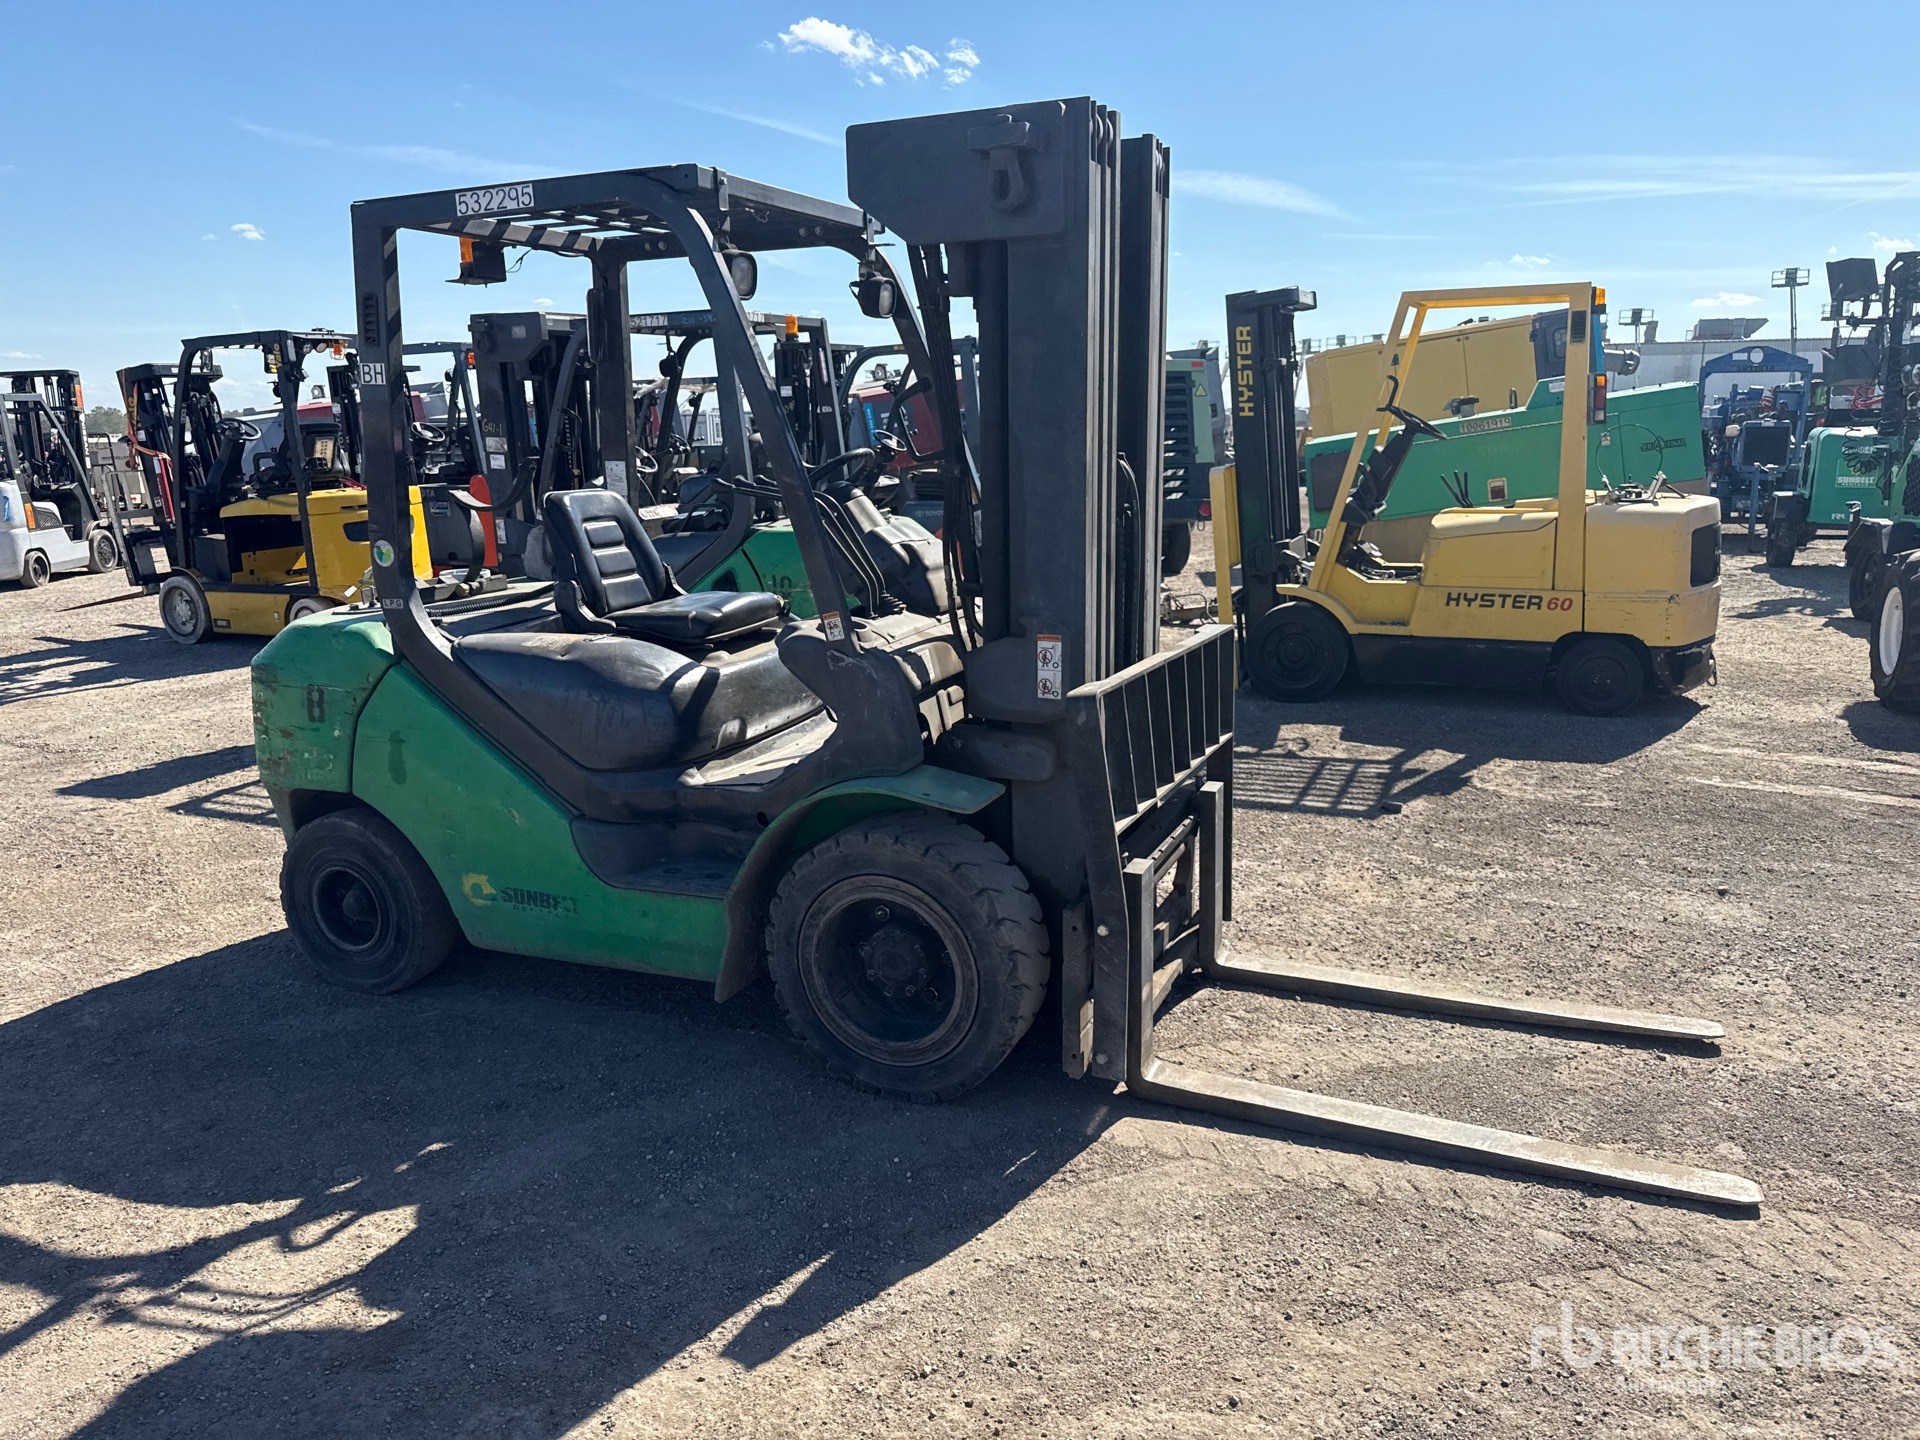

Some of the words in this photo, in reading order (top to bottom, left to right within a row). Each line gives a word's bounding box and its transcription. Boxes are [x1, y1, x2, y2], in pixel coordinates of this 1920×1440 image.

[458, 185, 532, 215] 532295
[362, 363, 385, 384] BH
[1235, 326, 1254, 416] HYSTER
[1837, 476, 1875, 484] SUNBELT
[1445, 592, 1543, 610] HYSTER
[1546, 597, 1573, 612] 60
